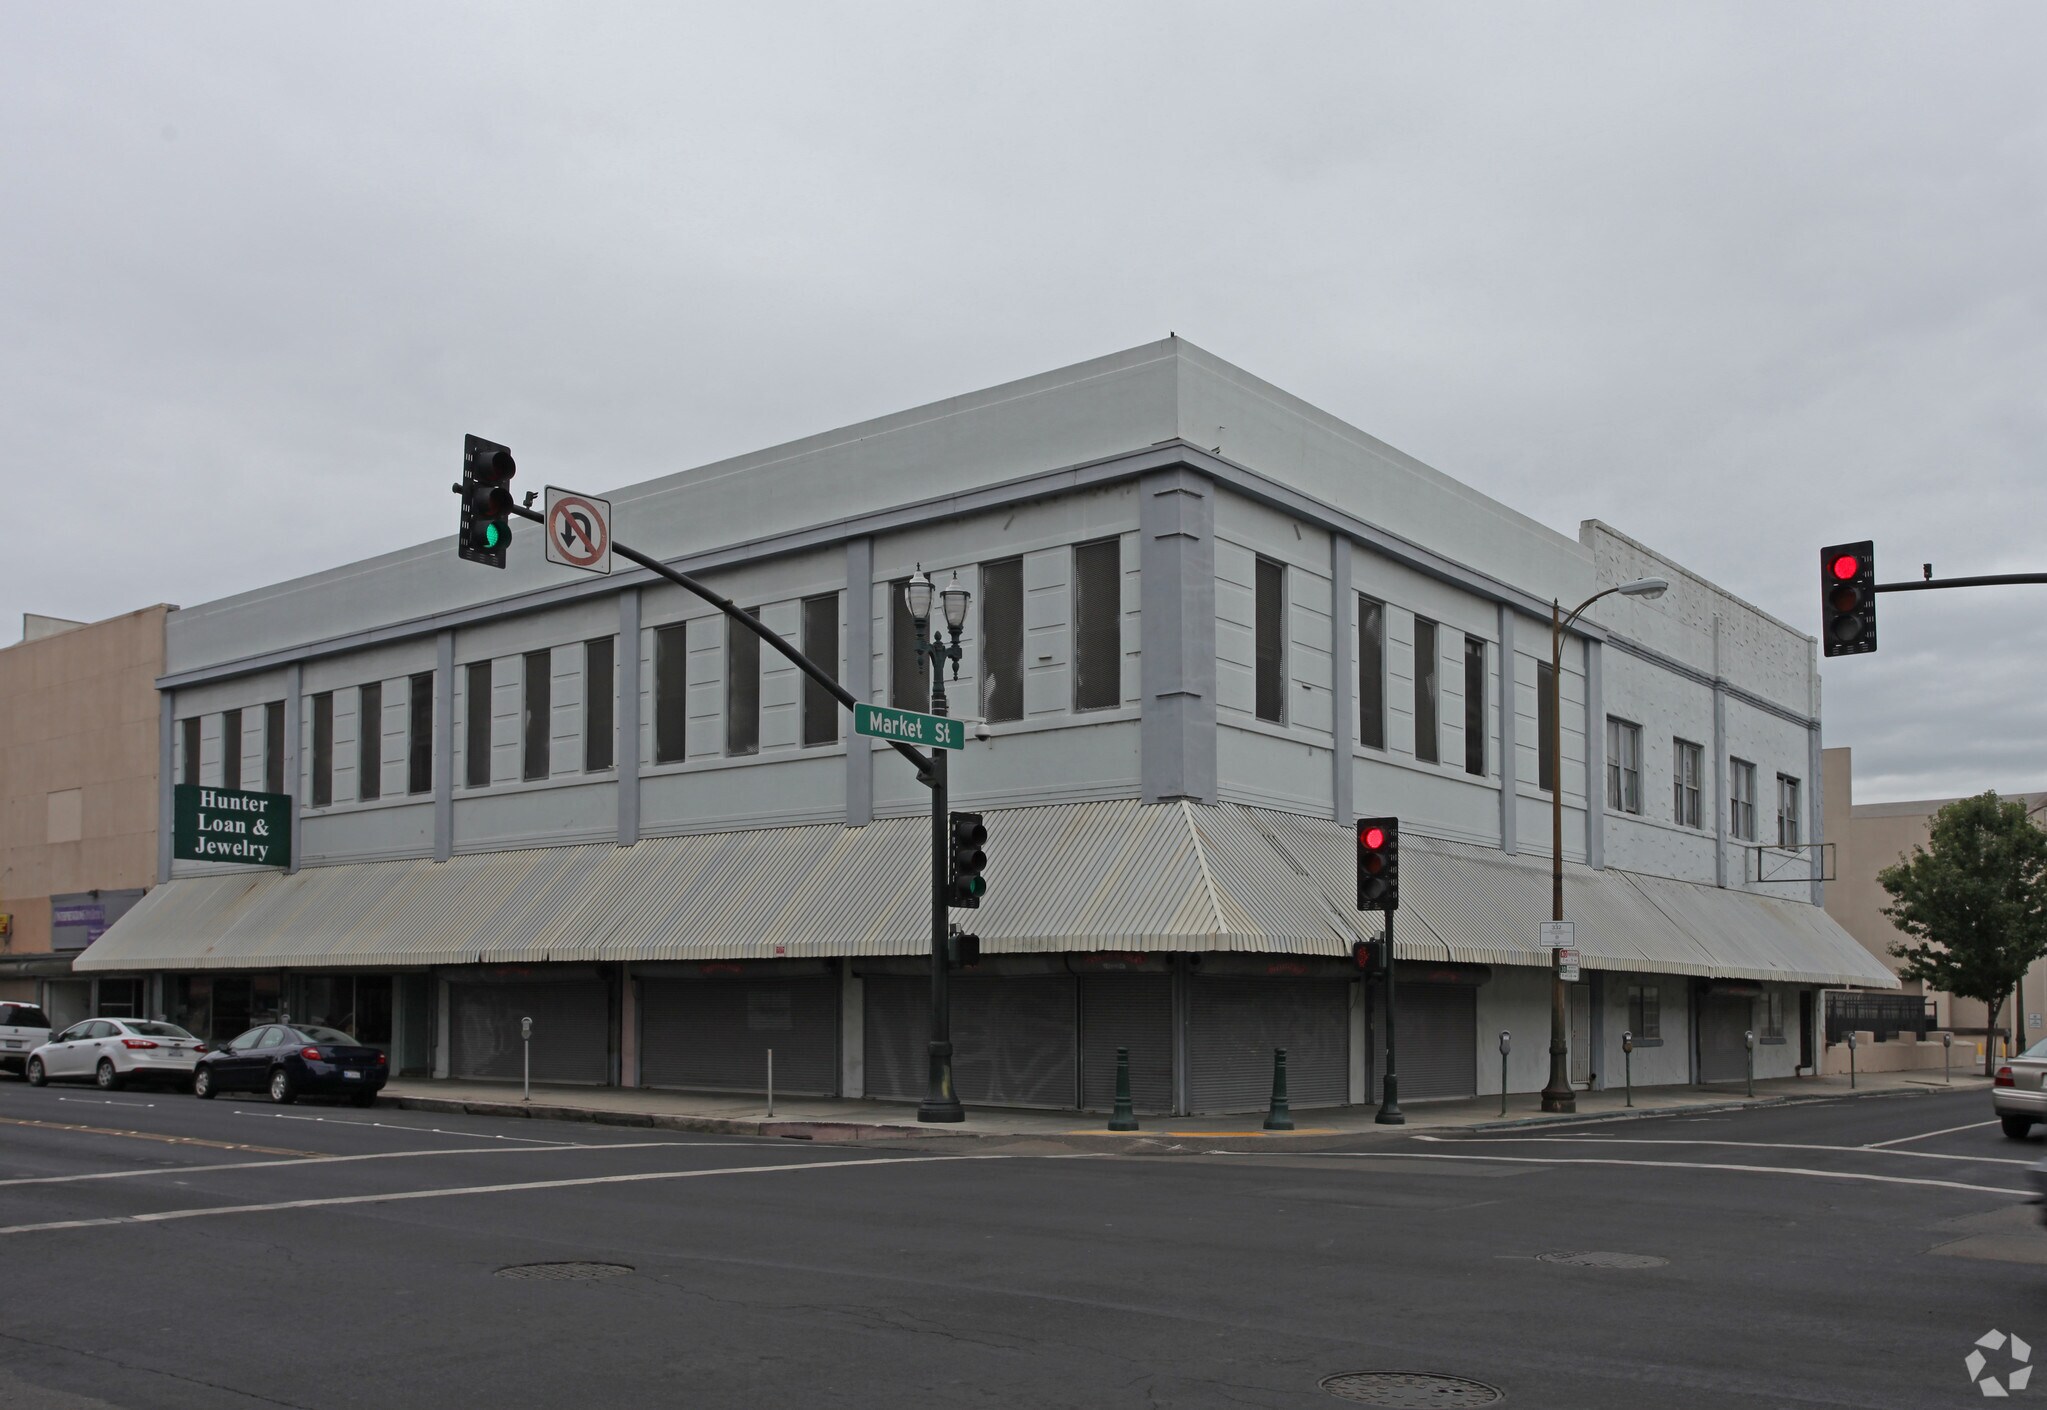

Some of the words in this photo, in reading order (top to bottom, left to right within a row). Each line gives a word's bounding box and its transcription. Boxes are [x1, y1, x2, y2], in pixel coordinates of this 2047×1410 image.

[870, 711, 922, 738] Market
[935, 723, 950, 743] St
[200, 790, 268, 812] Hunter
[198, 813, 246, 834] Loan
[252, 818, 269, 836] &
[194, 836, 269, 861] Jewelry
